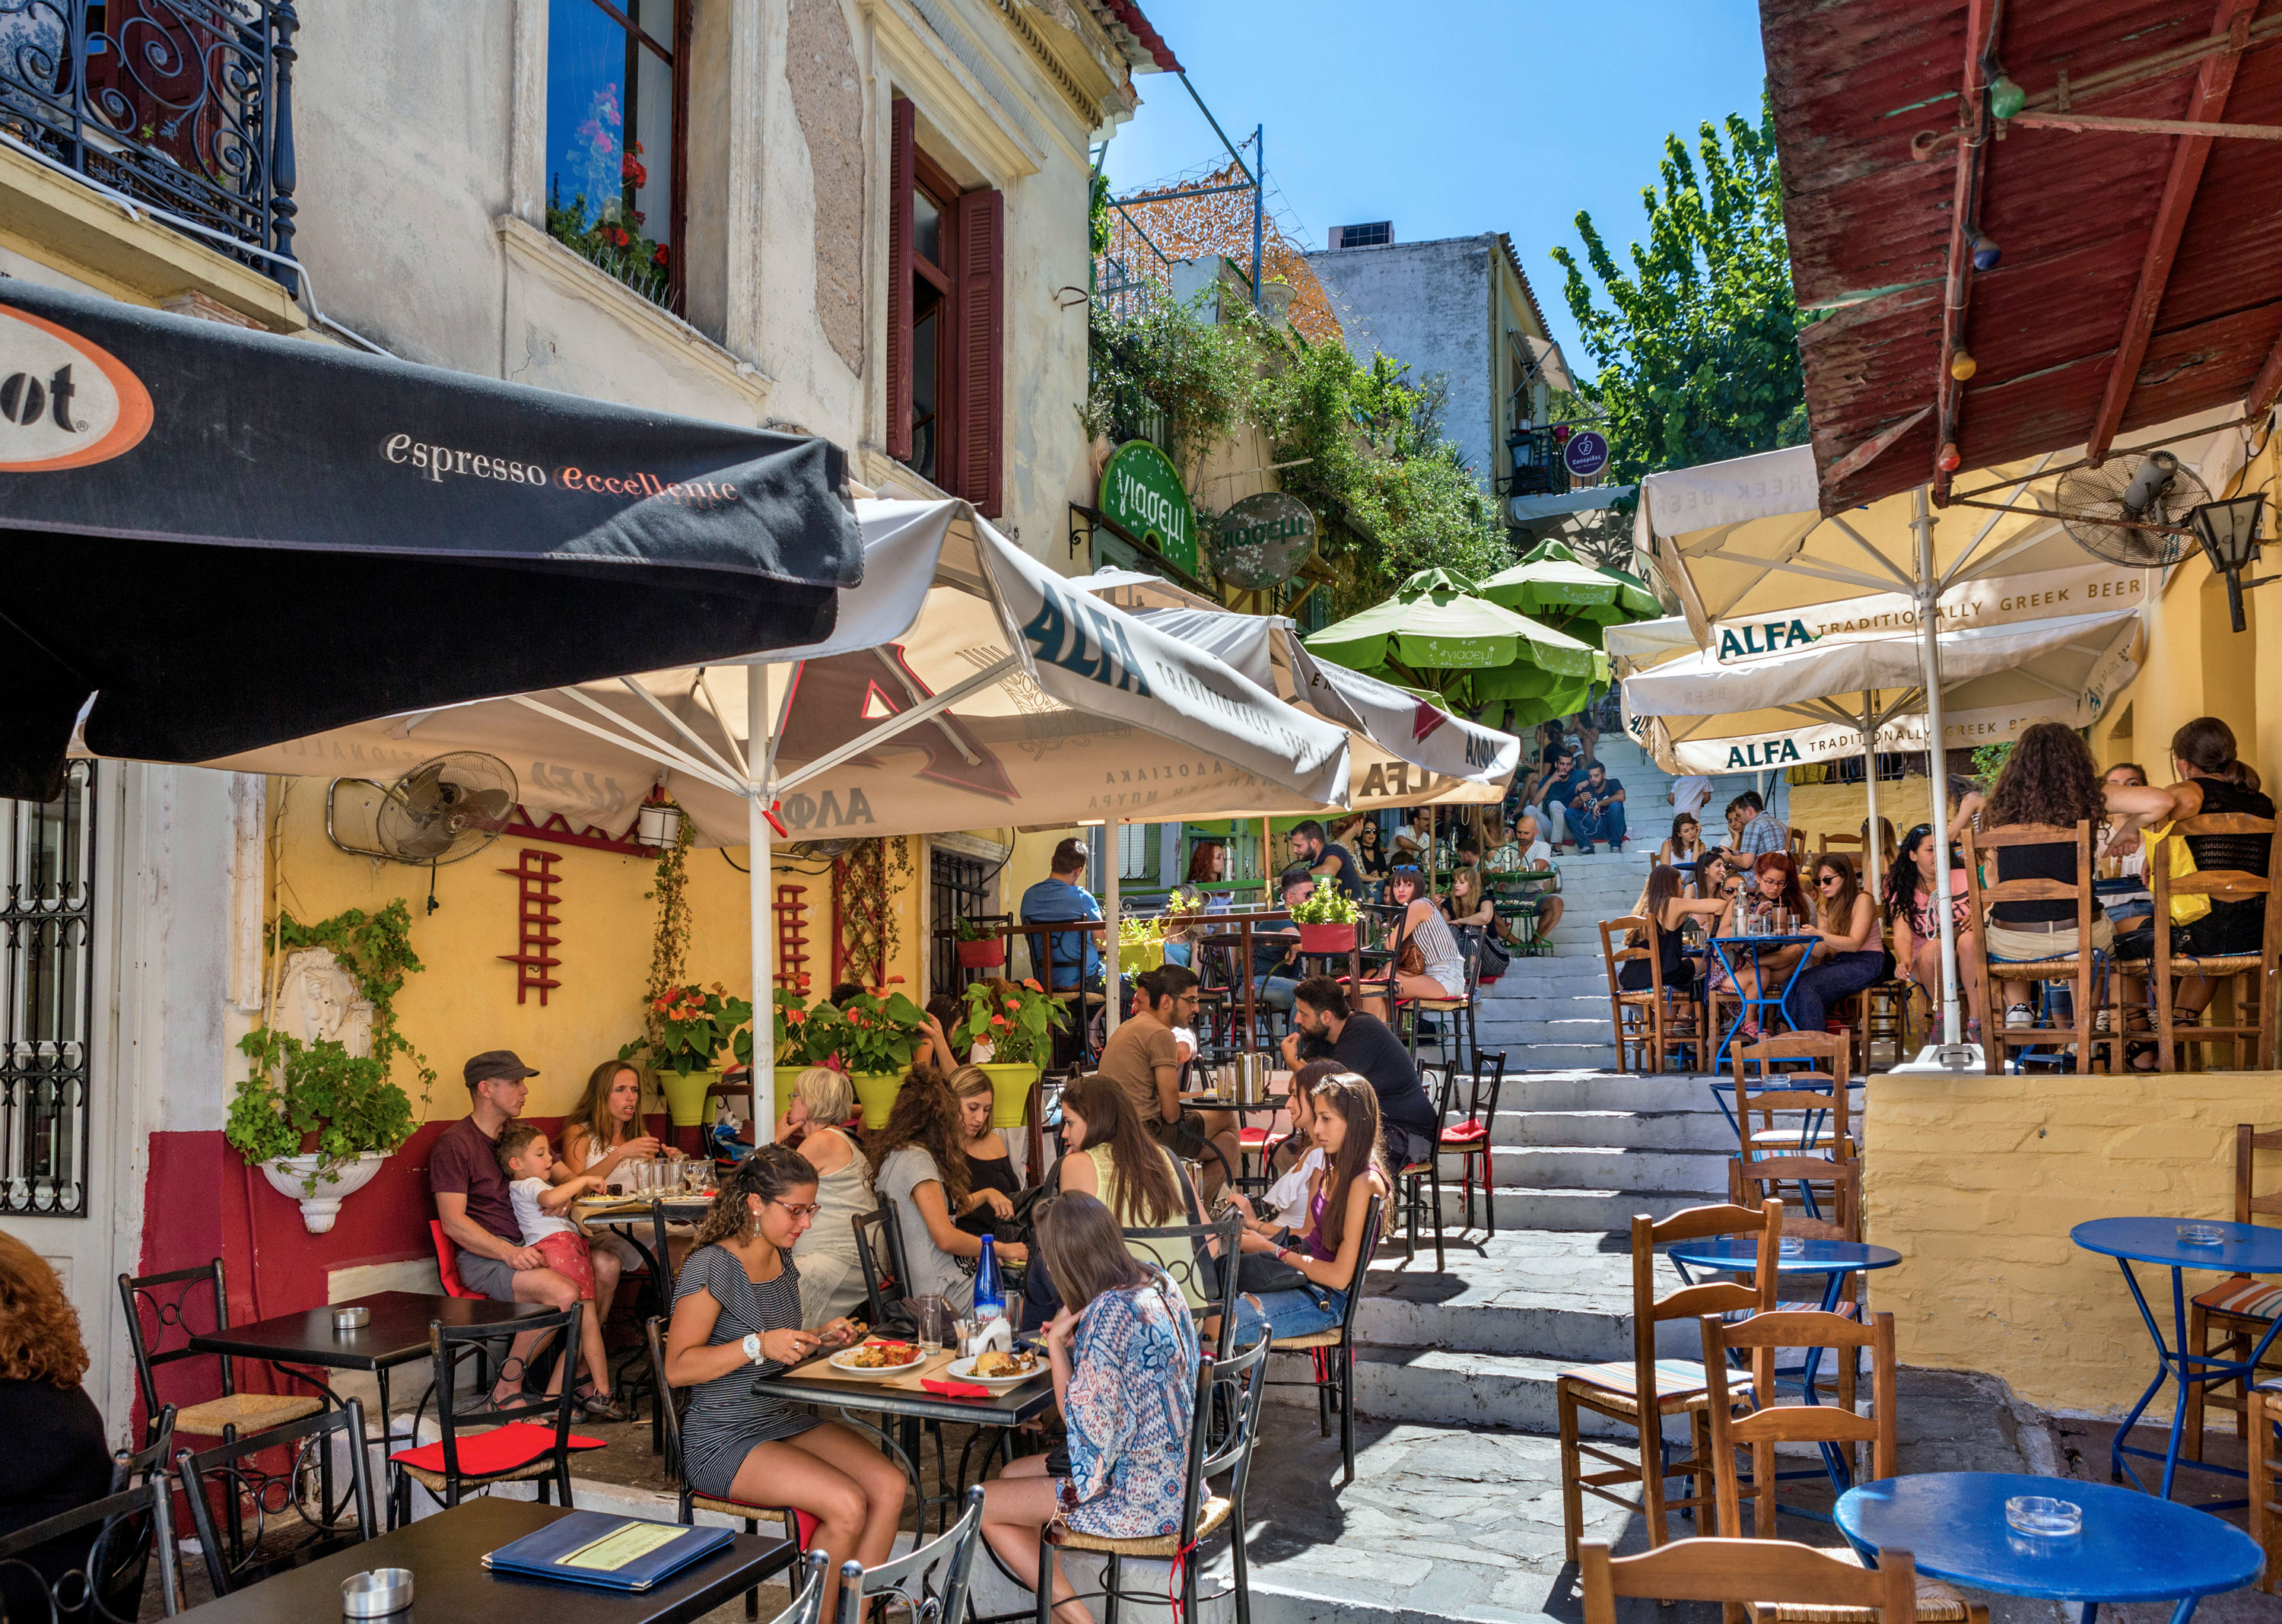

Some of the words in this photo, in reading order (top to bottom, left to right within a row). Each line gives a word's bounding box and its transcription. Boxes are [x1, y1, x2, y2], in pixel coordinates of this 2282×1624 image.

[385, 434, 547, 482] espresso
[561, 466, 738, 501] eccellente
[1023, 579, 1152, 698] ALFA
[1718, 619, 1813, 659] ALFA
[2000, 589, 2069, 611] GREEK
[2088, 580, 2140, 598] BEER
[1726, 738, 1801, 769] ALFA
[1810, 729, 1930, 752] TRADITONALLY
[1945, 723, 1997, 737] GREEK
